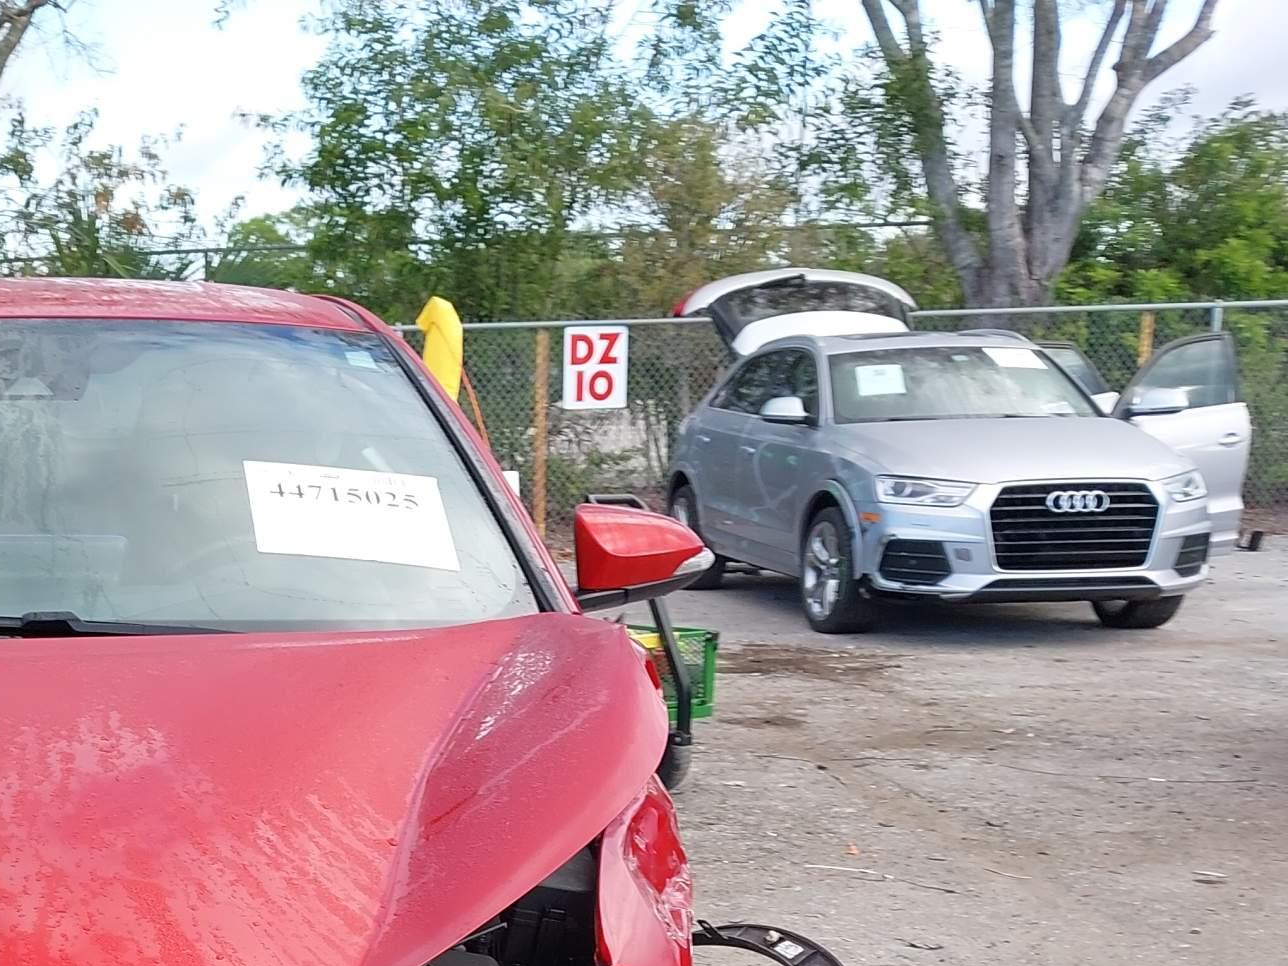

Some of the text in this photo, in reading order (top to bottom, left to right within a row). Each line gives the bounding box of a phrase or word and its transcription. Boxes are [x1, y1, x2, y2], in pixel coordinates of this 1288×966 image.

[571, 332, 620, 365] DZ
[576, 371, 613, 401] 10
[269, 482, 419, 510] 44715025
